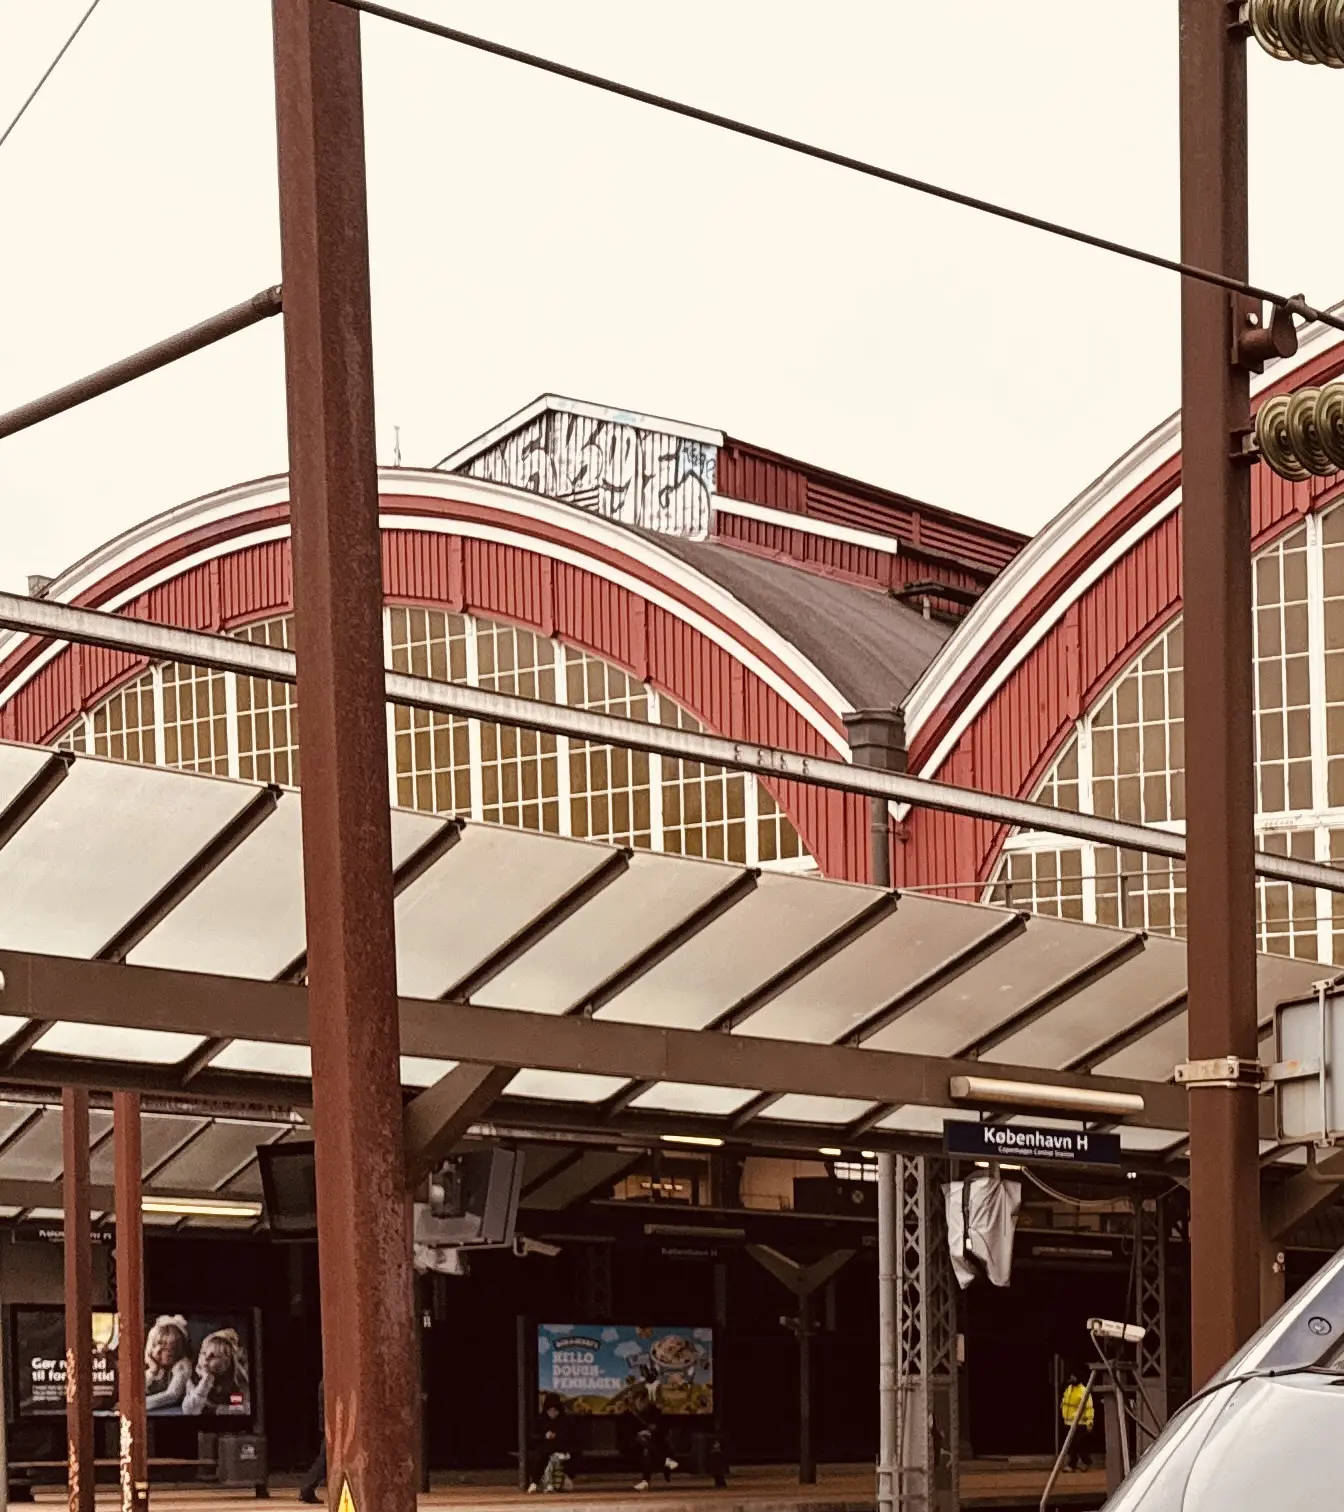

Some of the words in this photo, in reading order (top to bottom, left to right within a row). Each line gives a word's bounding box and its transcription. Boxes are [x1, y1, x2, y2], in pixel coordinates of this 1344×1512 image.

[983, 1126, 1072, 1150] København
[1076, 1134, 1089, 1151] H
[31, 1357, 56, 1370] Gør
[552, 1352, 595, 1364] HELLO
[32, 1370, 46, 1382] til
